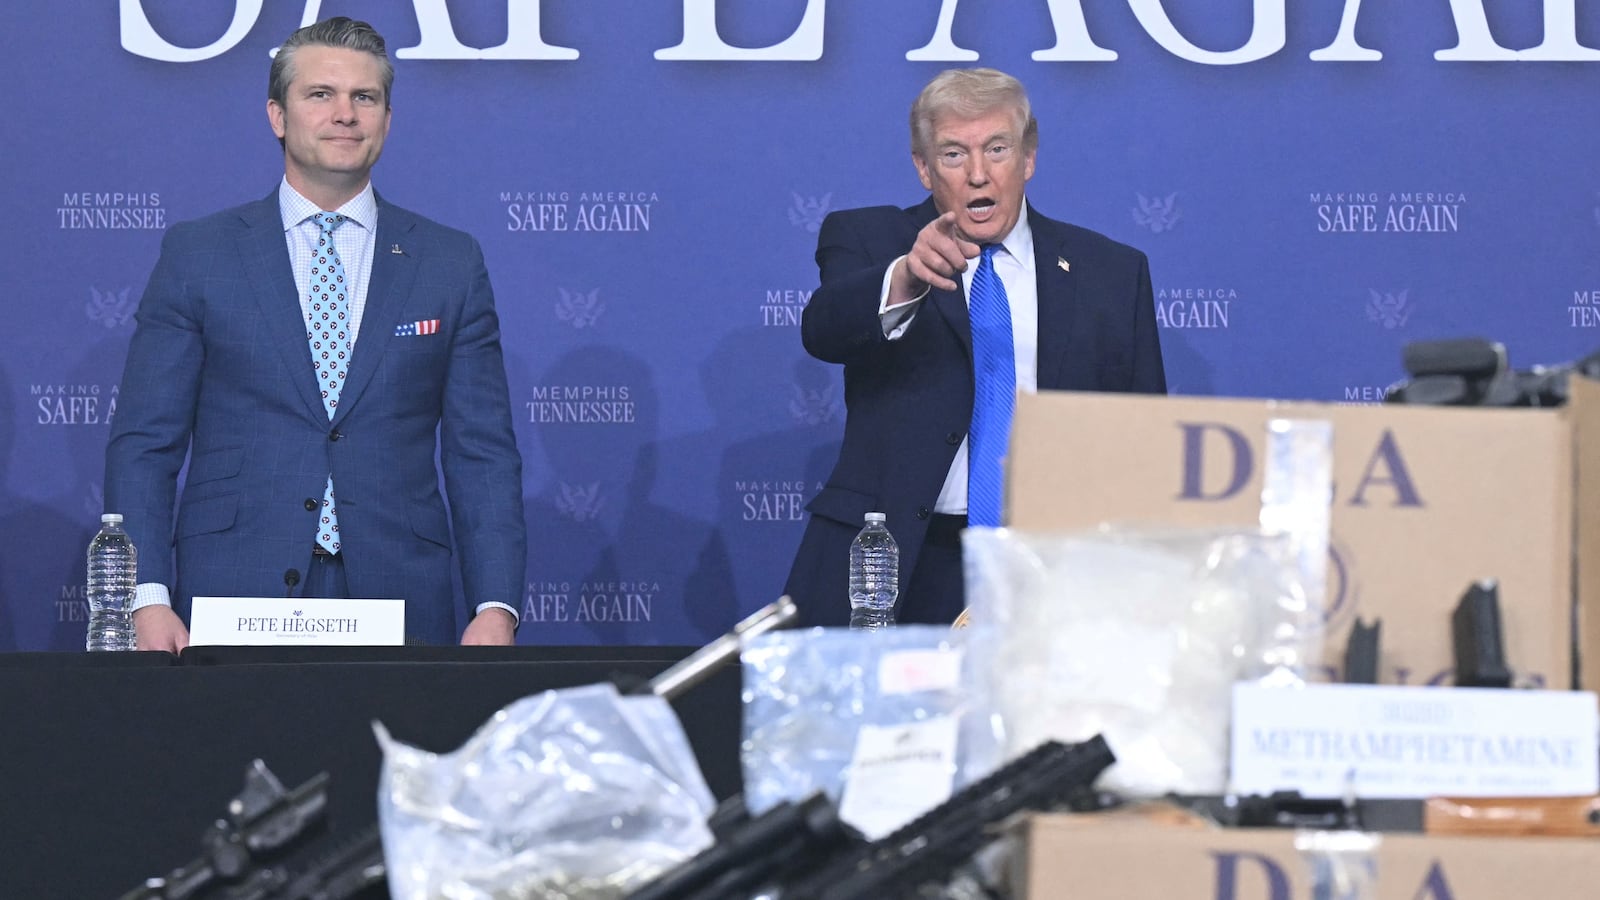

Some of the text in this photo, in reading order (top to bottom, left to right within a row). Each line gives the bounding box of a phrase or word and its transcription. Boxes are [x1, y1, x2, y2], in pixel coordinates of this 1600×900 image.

[64, 192, 161, 207] MEMPHIS
[500, 191, 660, 202] MAKING AMERICA
[1310, 192, 1468, 203] MAKING AMERICA
[57, 207, 166, 230] TENNESSEE
[507, 203, 650, 232] SAFE AGAIN
[1317, 204, 1460, 233] SAFE AGAIN
[1158, 288, 1238, 299] AMERICA
[1156, 300, 1230, 329] AGAIN
[30, 384, 101, 396] MAKING
[532, 385, 630, 401] MEMPHIS
[37, 396, 99, 425] SAFE
[526, 401, 636, 423] TENNESSEE
[1174, 420, 1424, 508] DA
[735, 481, 806, 492] MAKING
[742, 492, 804, 521] SAFE
[527, 582, 661, 593] KING AMERICA
[521, 594, 652, 623] AFE AGAIN
[237, 617, 359, 633] PETE HEGSETH
